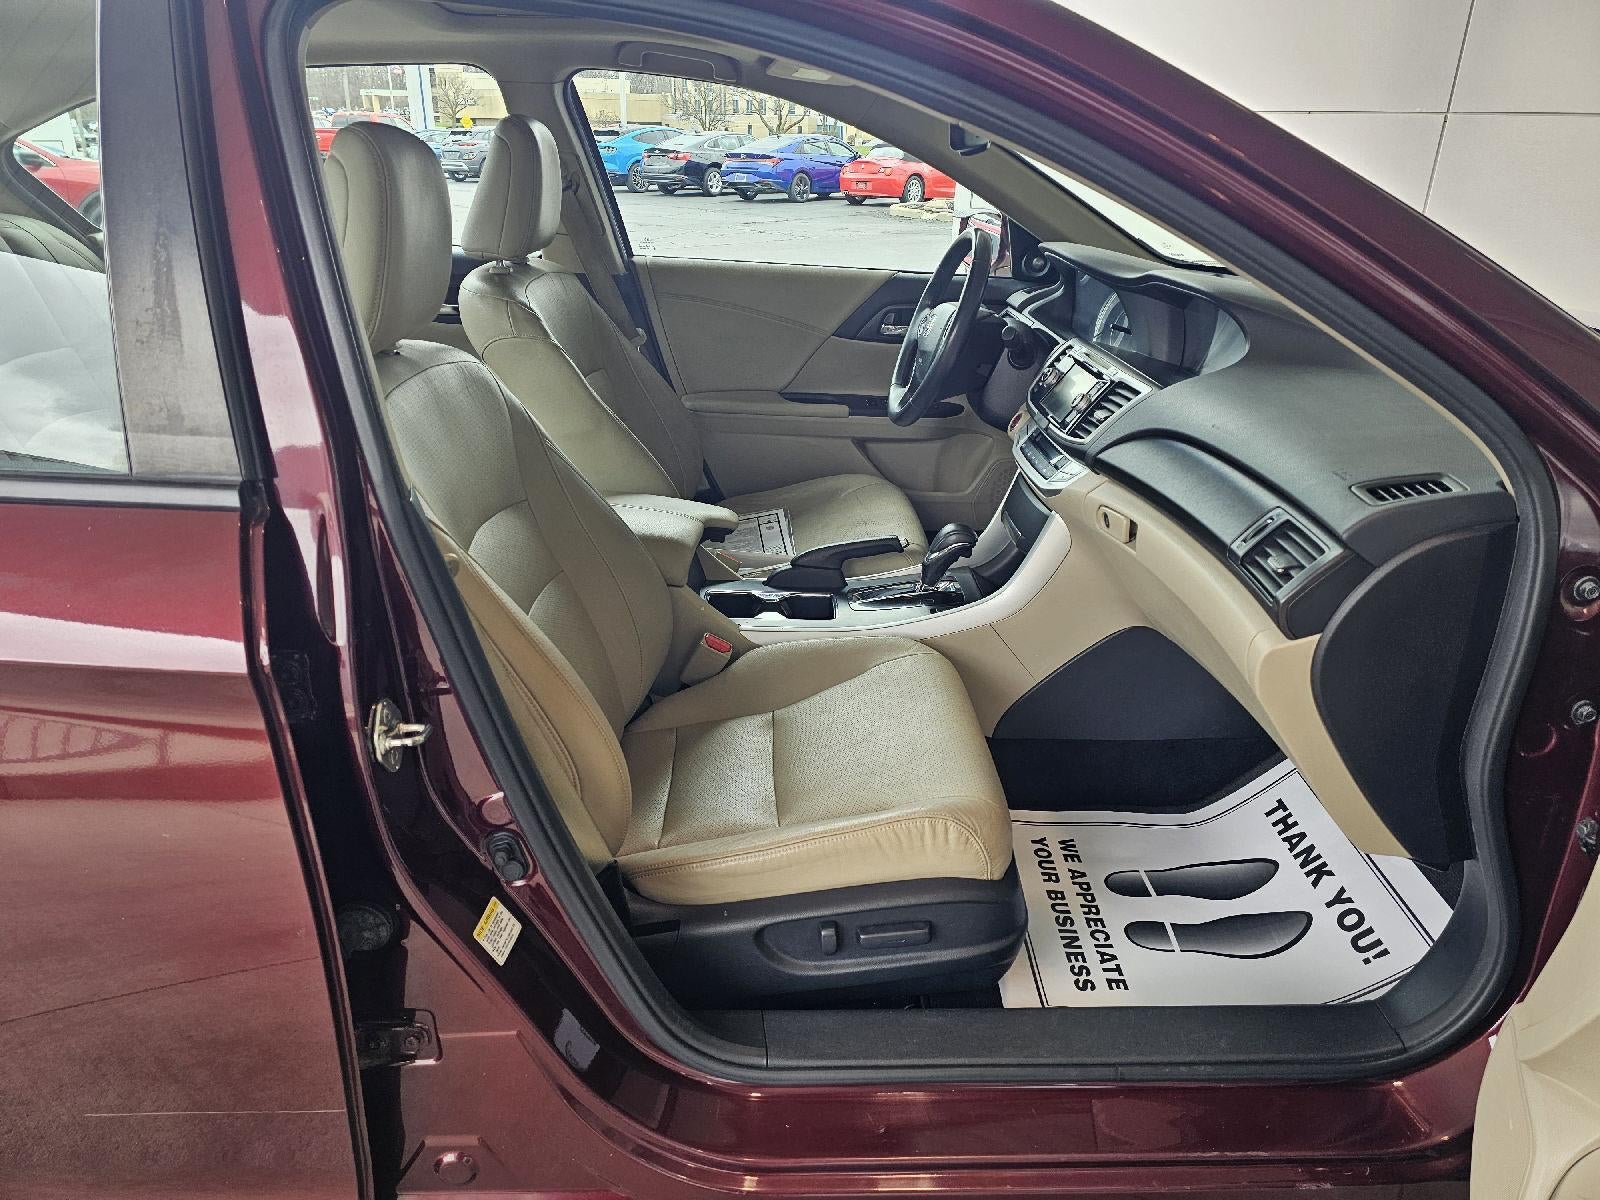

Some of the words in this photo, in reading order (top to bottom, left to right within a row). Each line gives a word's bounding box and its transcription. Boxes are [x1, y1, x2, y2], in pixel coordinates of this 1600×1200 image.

[1030, 836, 1061, 884] YOUR
[1057, 838, 1083, 864] WE
[1263, 797, 1336, 890] THANK
[1324, 885, 1391, 966] YOU!
[1045, 889, 1097, 992] BUSINESS
[1067, 867, 1130, 991] APPRECIATE
